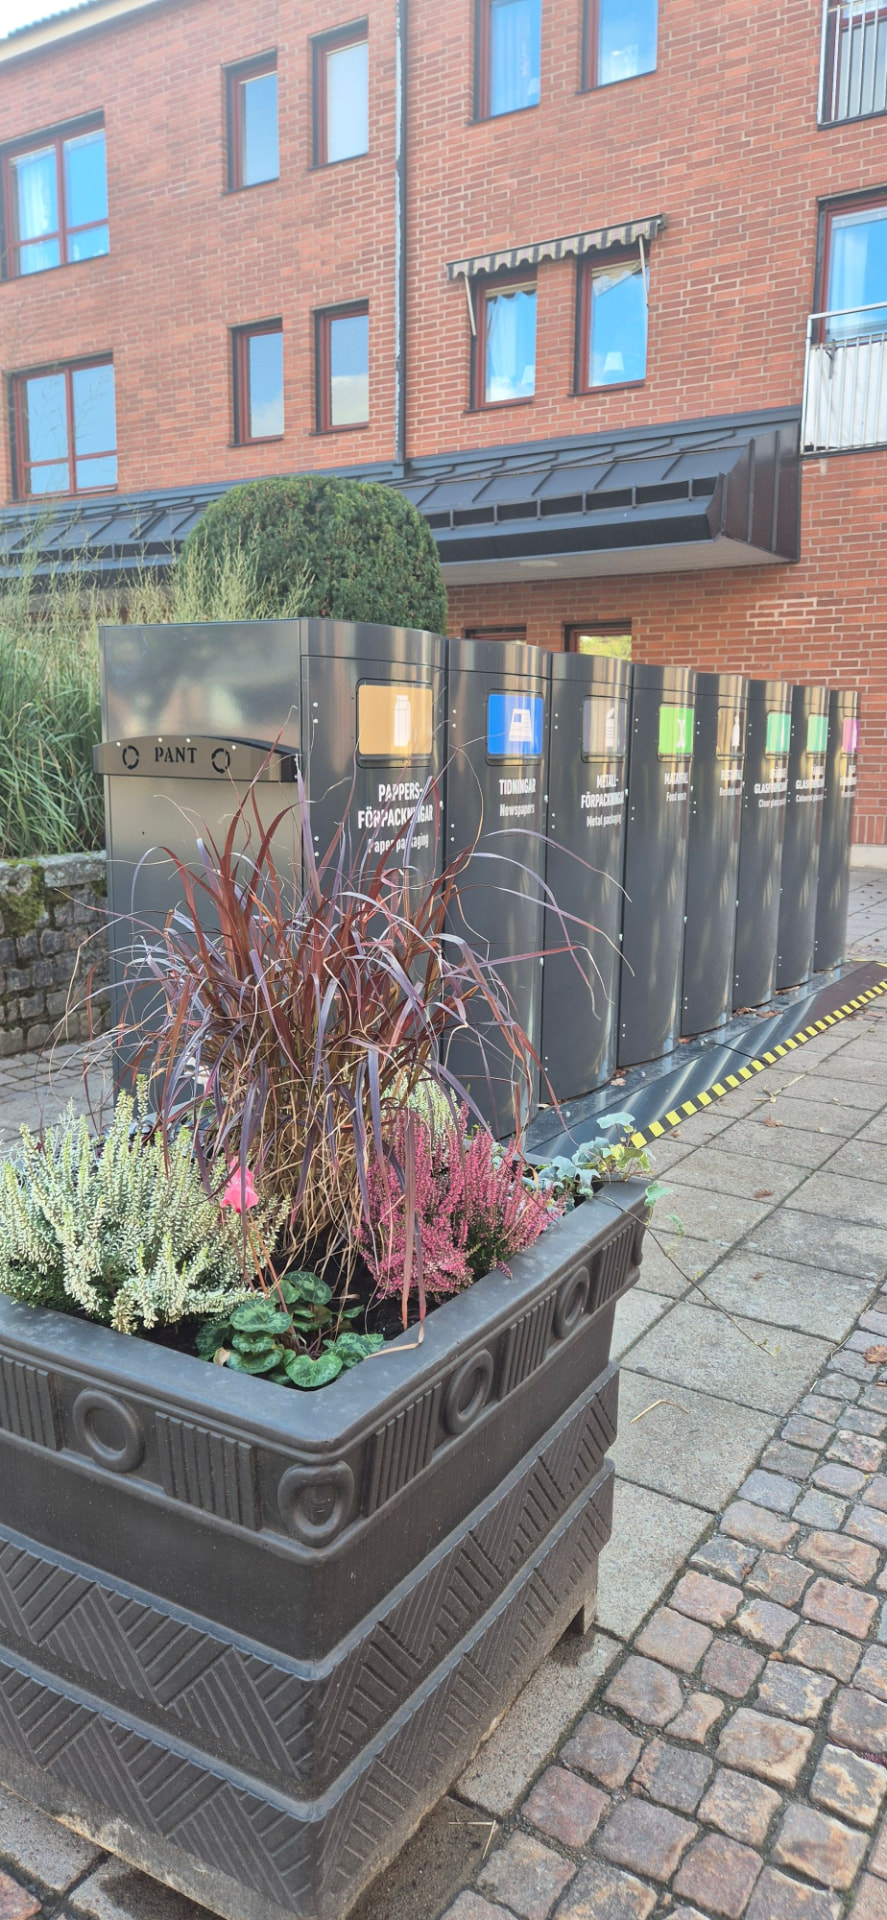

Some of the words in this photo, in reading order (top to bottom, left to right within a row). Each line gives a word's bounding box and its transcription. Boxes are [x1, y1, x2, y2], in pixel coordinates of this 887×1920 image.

[154, 746, 198, 764] PANT
[378, 781, 424, 802] PAPPERS-
[498, 777, 536, 795] TIDNINGAR
[499, 803, 535, 818] Newspapers
[396, 833, 429, 853] paaging
